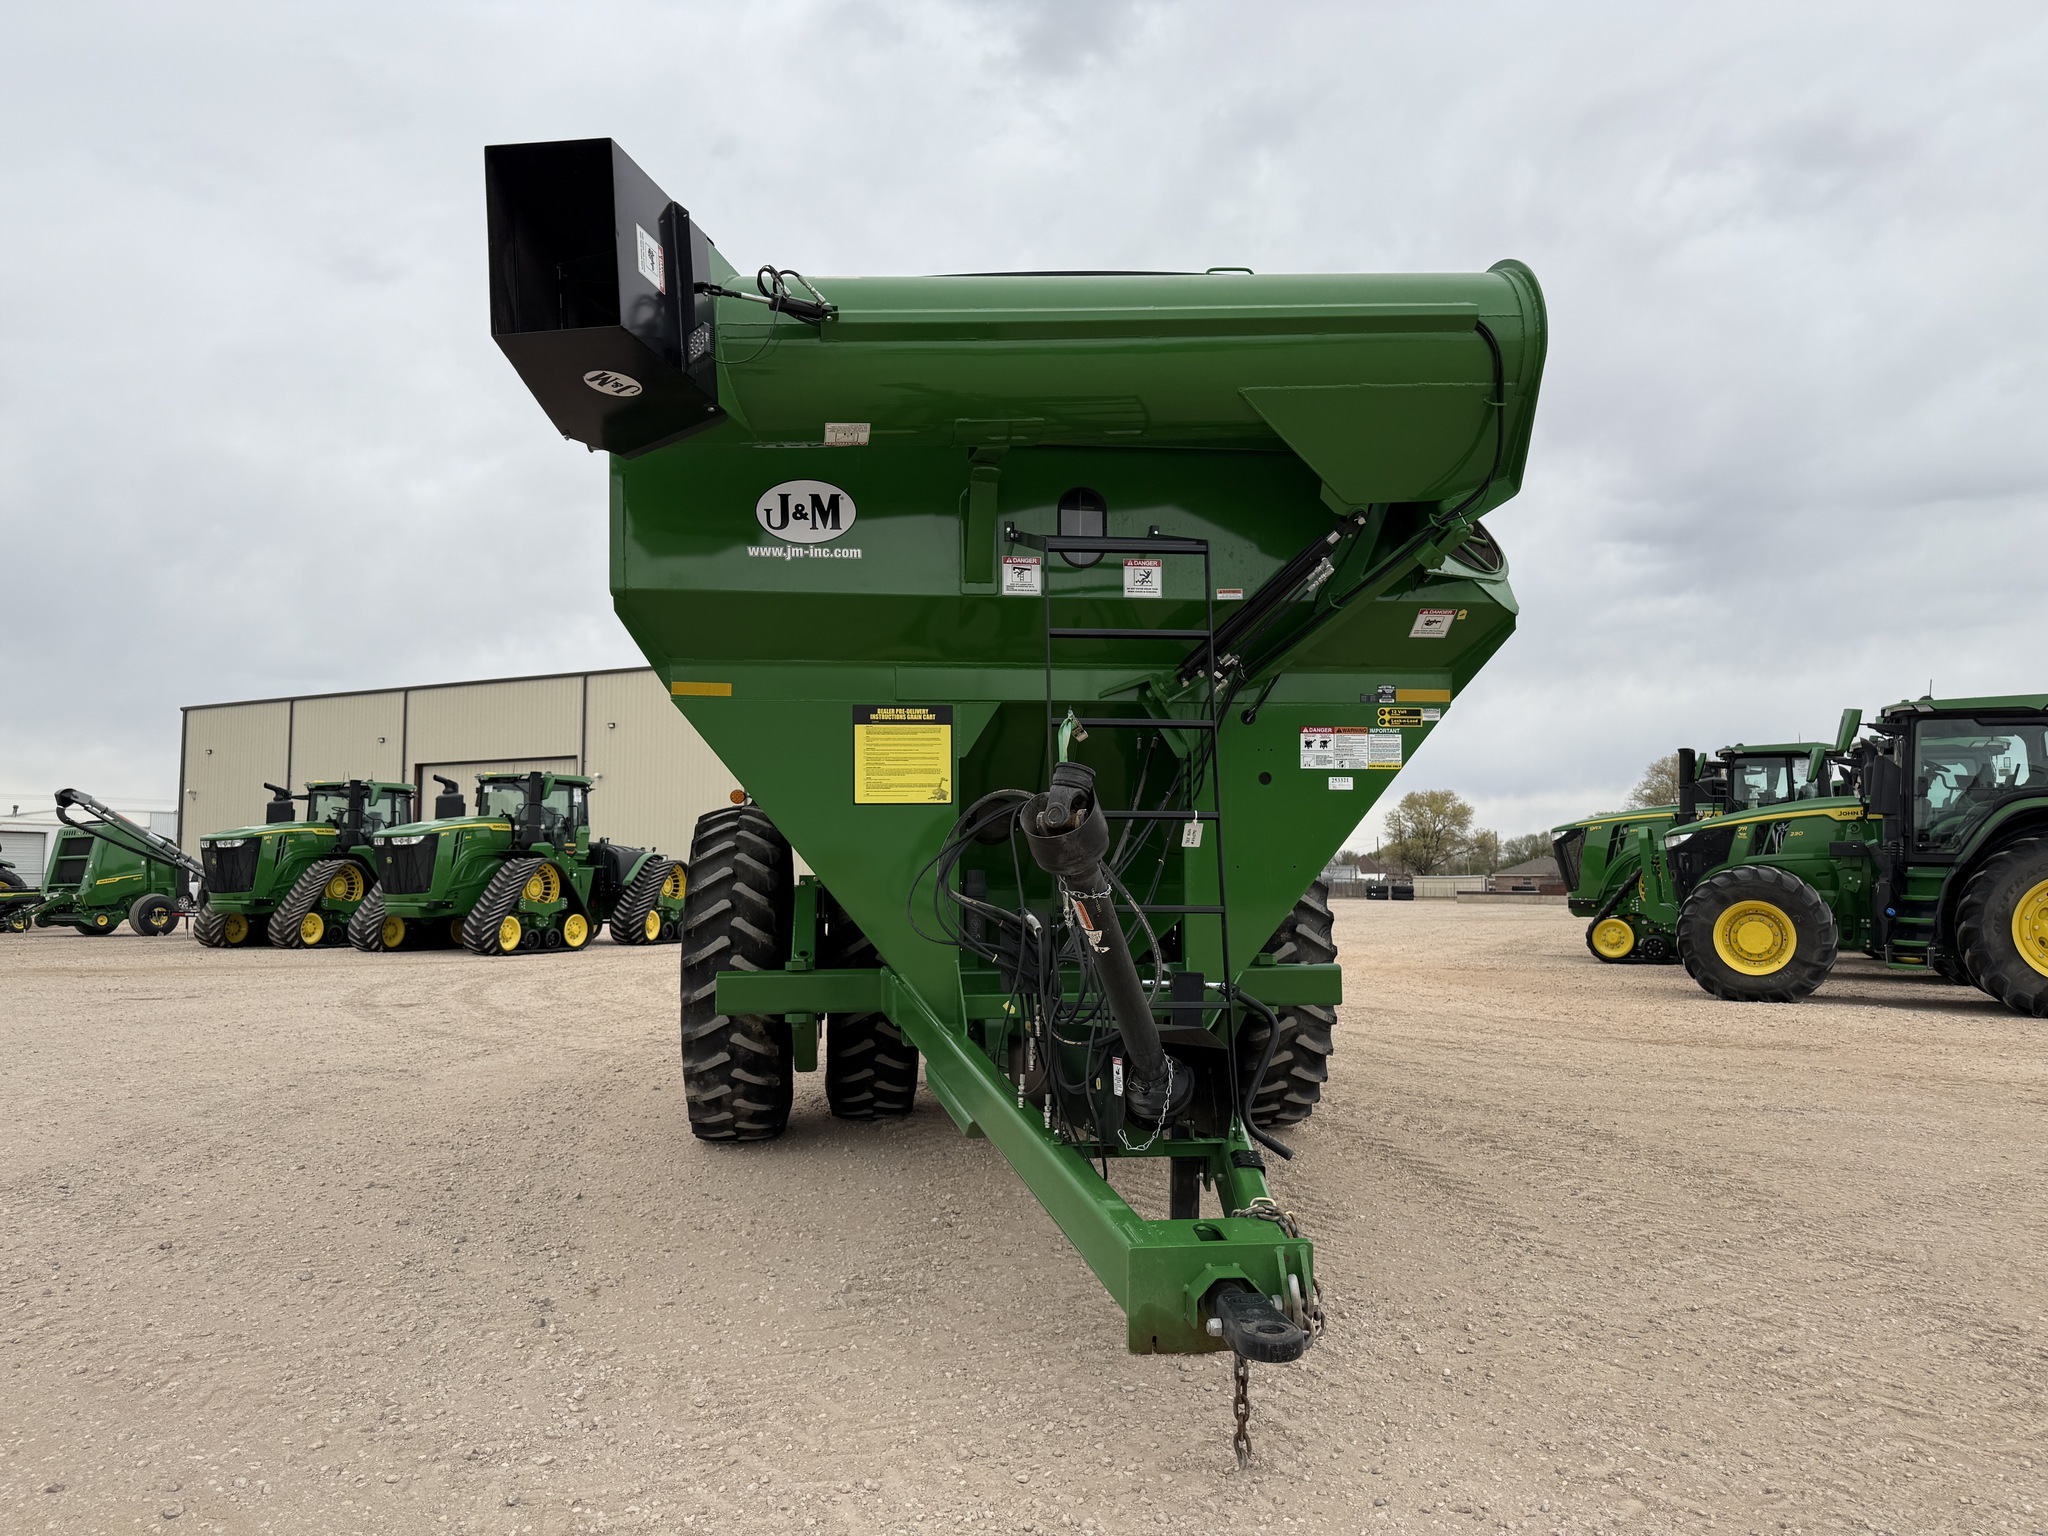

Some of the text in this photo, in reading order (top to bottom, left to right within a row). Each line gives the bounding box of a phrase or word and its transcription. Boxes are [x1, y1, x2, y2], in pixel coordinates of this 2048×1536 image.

[586, 372, 640, 394] J&M
[764, 493, 842, 530] J&M
[747, 545, 862, 560] www.jm-inc.com
